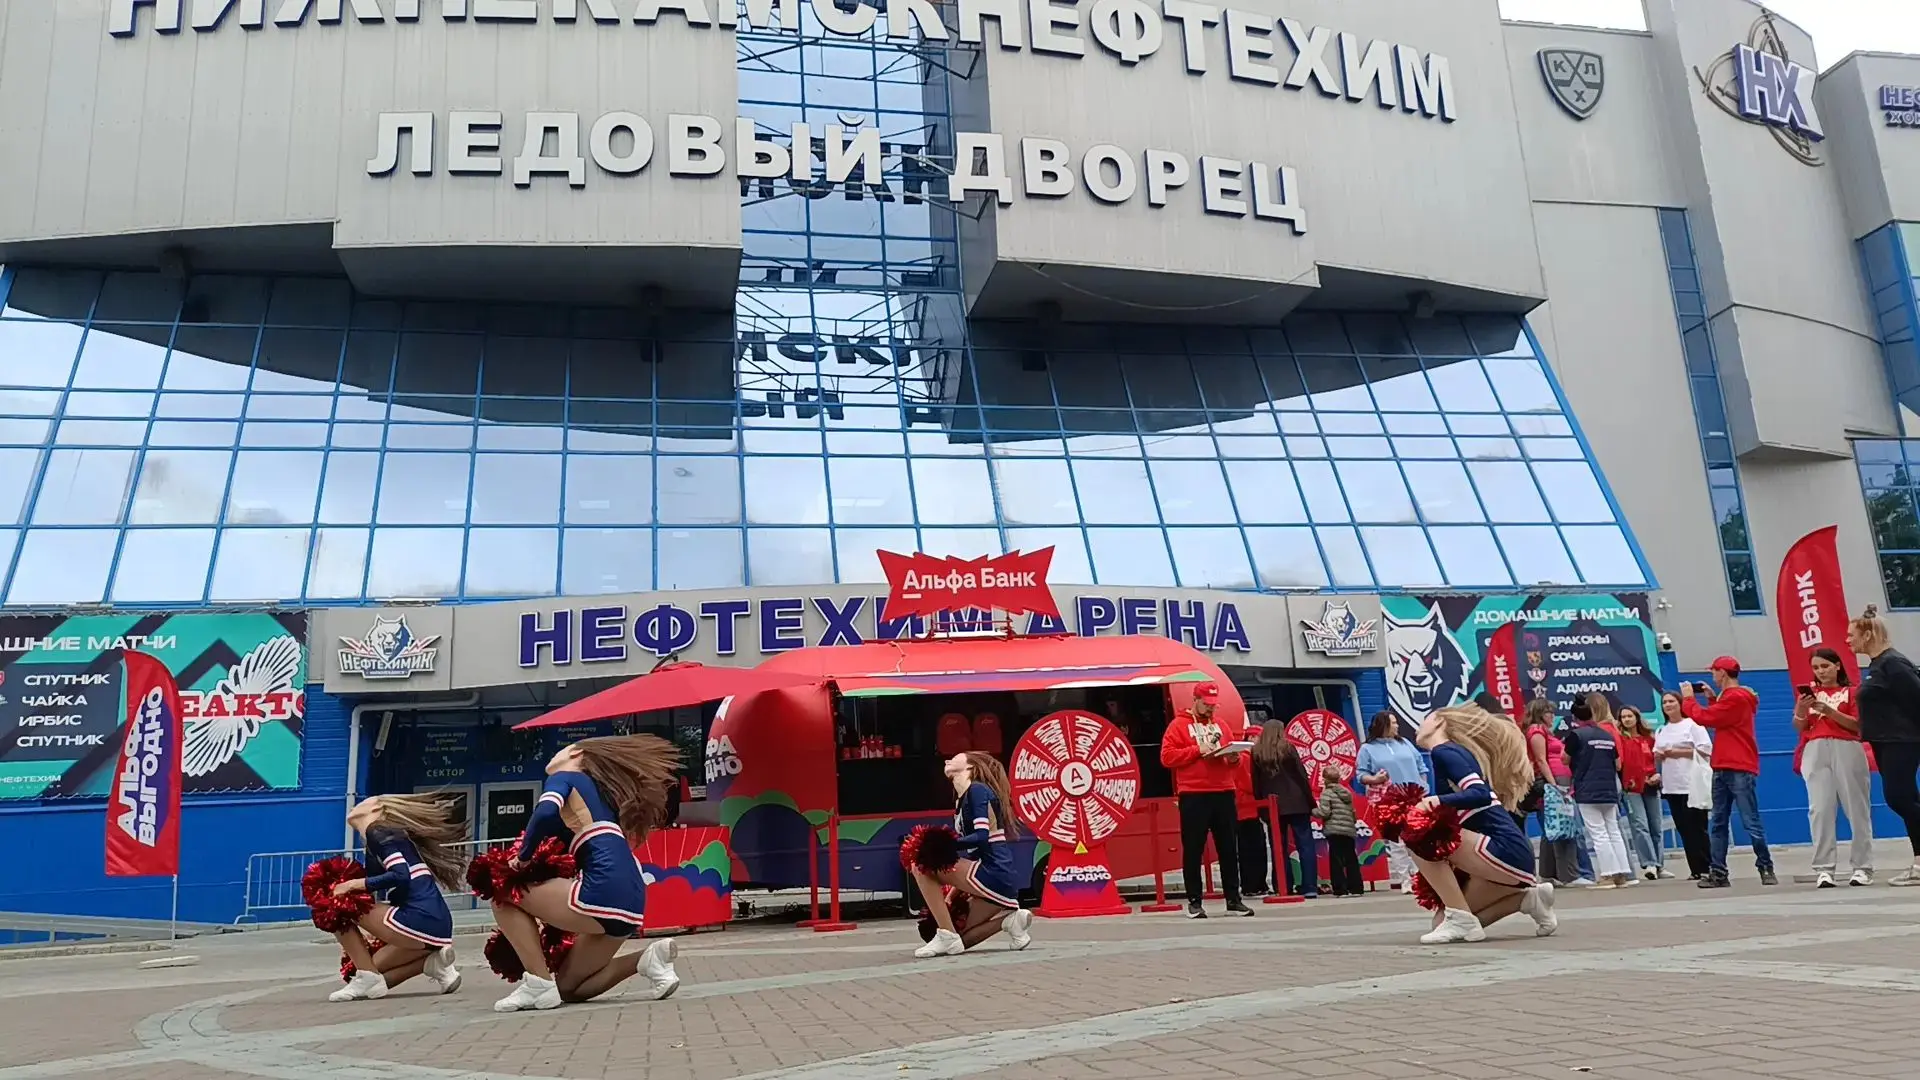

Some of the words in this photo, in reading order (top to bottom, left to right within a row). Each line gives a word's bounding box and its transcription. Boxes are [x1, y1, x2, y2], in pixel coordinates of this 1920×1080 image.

[367, 110, 884, 188] ЛЕДОВЫЙ
[949, 131, 1306, 235] ДВОРЕЦ
[903, 568, 977, 595] Альфа
[980, 567, 1037, 588] Банк
[1473, 608, 1577, 624] ДОМАШНИЕ
[1581, 607, 1640, 621] МАТЧИ
[1794, 569, 1823, 649] Банк
[0, 636, 81, 651] ШНИЕ
[87, 635, 177, 650] МАТЧИ
[1547, 635, 1610, 647] ДРАКОНЫ
[341, 651, 434, 670] НЕФТЕХИМИК
[1550, 652, 1586, 662] СОЧИ
[1553, 666, 1642, 678] АВТОМОБИЛИСТ
[24, 673, 111, 686] СПУТНИК
[1556, 682, 1618, 695] АДМИРАЛ
[21, 692, 88, 706] ЧАЙКА
[18, 714, 83, 727] ИРБИС
[16, 735, 104, 747] СПУТНИК
[1090, 736, 1131, 772] СТИЛЬ
[138, 685, 165, 848] ВЫГОДНО
[1014, 748, 1059, 780] ВЫБИРАЙ
[426, 768, 465, 777] СЕКТОР
[1019, 785, 1061, 822] СТИЛЬ
[1051, 865, 1108, 875] АЛЬФА
[1050, 873, 1112, 883] ВЫГОДНО
